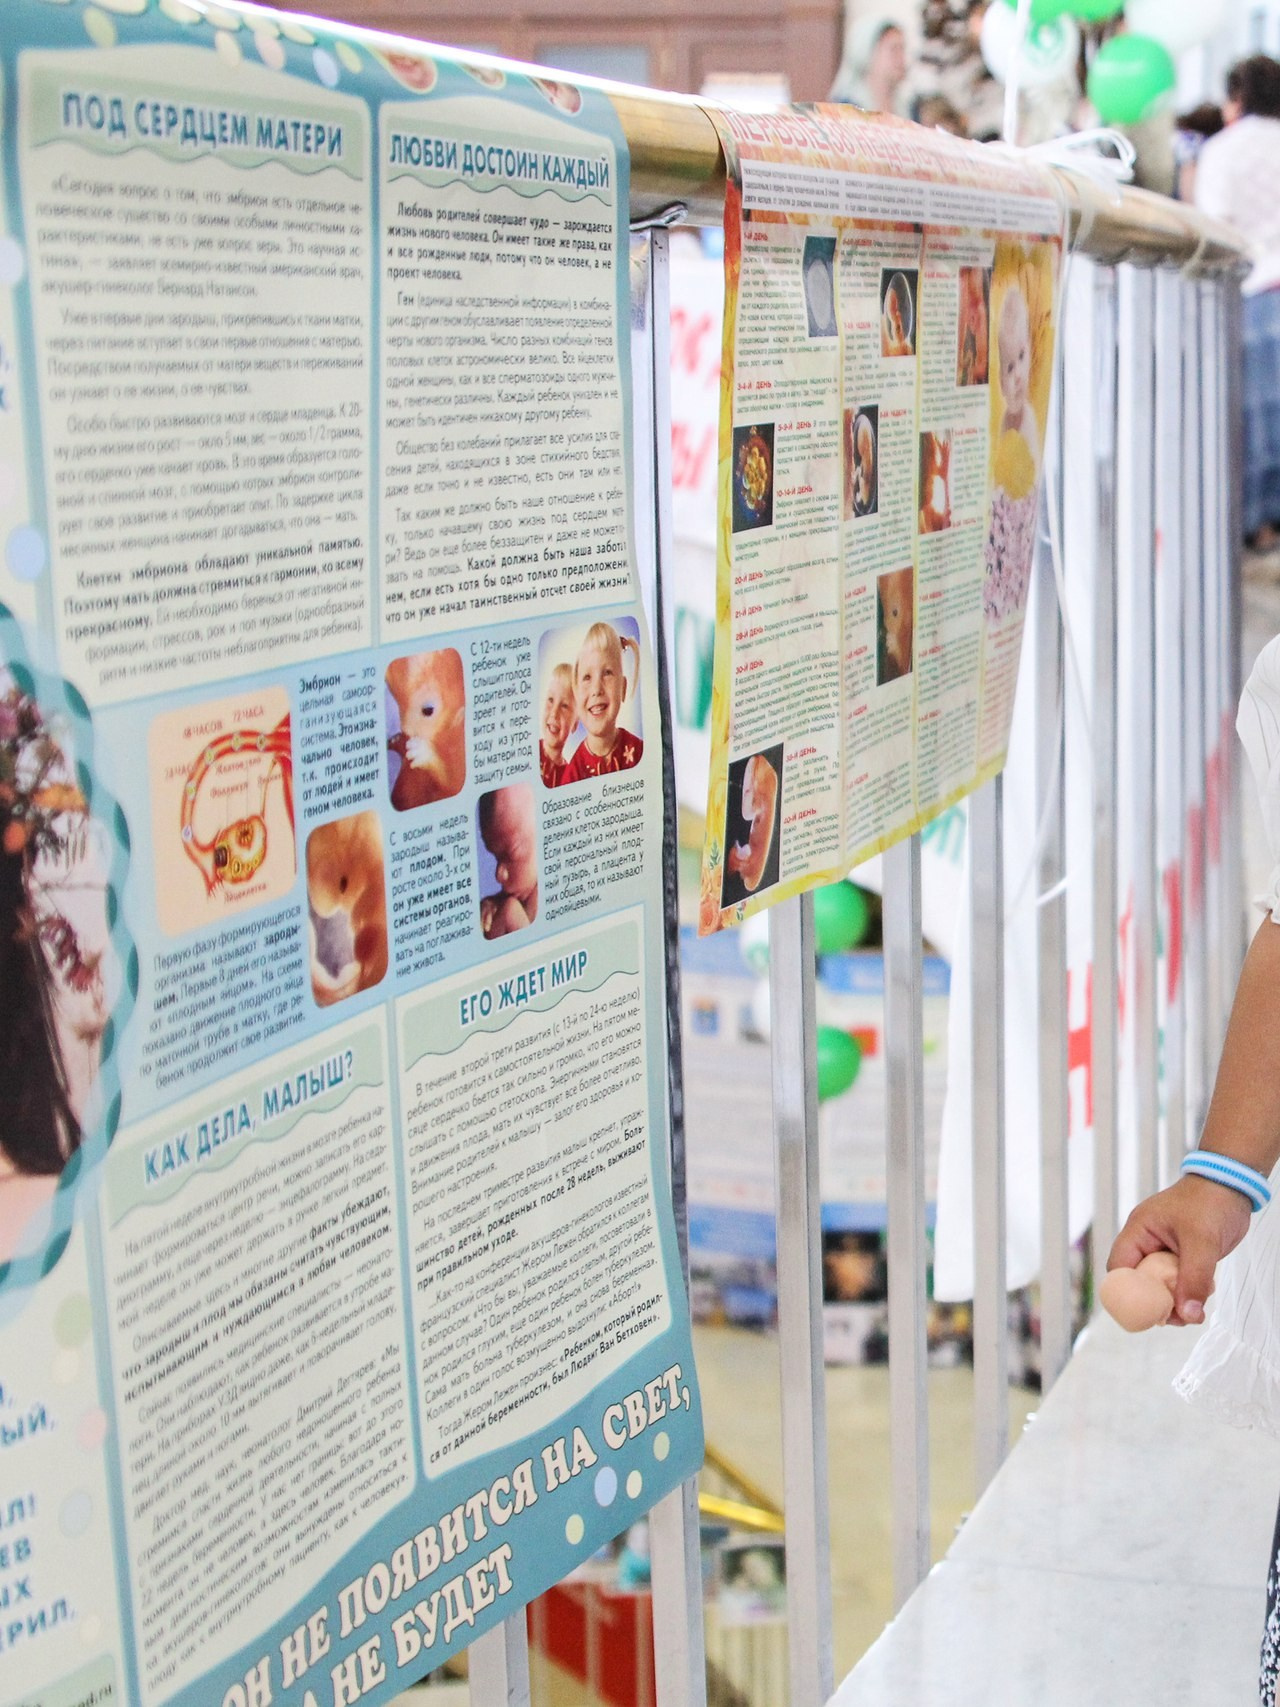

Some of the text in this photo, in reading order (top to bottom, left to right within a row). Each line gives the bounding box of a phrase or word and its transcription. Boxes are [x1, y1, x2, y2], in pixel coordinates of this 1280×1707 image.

[63, 93, 342, 157] ПОД СЕРДЦЕМ МАТЕРИ
[390, 134, 609, 190] ЛЮБВИ ДОСТОИН КАЖДЫЙ
[397, 202, 612, 233] Любовь родителей совершает чудо зарождается
[387, 228, 611, 252] жизнь нового человека. Он имеет такие же права, как
[387, 247, 611, 269] и все рожденные люди, потому что он человек, а не
[387, 268, 462, 281] проект человека.
[756, 380, 771, 389] ДЕНЬ
[796, 421, 811, 430] ДЕНЬ
[797, 486, 812, 496] ДЕНЬ
[467, 547, 592, 570] Какой должна быть наша
[386, 571, 557, 604] нем, если есть хотя бы одно только
[749, 572, 763, 582] ДЕНЬ
[386, 612, 400, 623] что
[404, 610, 415, 621] он
[419, 607, 436, 622] уже
[440, 602, 466, 615] начал
[470, 587, 537, 610] таинственный
[541, 586, 567, 599] отсчет
[570, 578, 595, 594] своей
[748, 605, 762, 616] ДЕНЬ
[750, 627, 763, 637] ДЕНЬ
[471, 637, 530, 656] С 12-ти недель
[472, 652, 531, 673] ребенок уже
[505, 668, 531, 680] голоса
[750, 660, 763, 670] ДЕНЬ
[299, 667, 376, 694] Эмбрион это
[474, 681, 531, 708] родителей. Он
[302, 736, 378, 765] чально человек,
[474, 731, 531, 752] ходу из утро-
[799, 747, 816, 758] ДЕНЬ
[303, 769, 379, 801] от людей и имеет
[474, 762, 532, 784] защиту семьи.
[304, 789, 374, 818] геном человека.
[542, 779, 644, 814] Образование близнецов
[543, 794, 644, 830] связано с особенностями
[798, 808, 816, 819] ДЕНЬ
[390, 814, 468, 846] С восьми недель
[544, 809, 643, 846] деления клеток зародыша.
[410, 845, 470, 873] плодом. При
[392, 862, 471, 899] росте около 3-х см
[394, 877, 472, 913] он уже имеет все
[394, 893, 472, 929] системы органов,
[461, 951, 587, 1025] ЕГО ЖДЕТ МИР
[144, 1051, 353, 1184] КАК ДЕЛА, МАЛЫШ?
[624, 1124, 645, 1142] Боль-
[416, 1139, 646, 1273] шинство детей, рожденных после 28 недель, выживают
[559, 1293, 662, 1363] «Ребенком, который родил-
[430, 1451, 441, 1464] ся
[443, 1443, 453, 1455] от
[454, 1417, 486, 1449] данной
[488, 1382, 551, 1426] беременности,
[552, 1367, 569, 1385] был
[571, 1348, 598, 1375] Людвиг
[600, 1340, 615, 1354] Ван
[220, 1364, 690, 1707] ОН НЕ ПОЯВИТСЯ НА СВЕТ,
[330, 1544, 514, 1707] НЕ БУДЕТ
